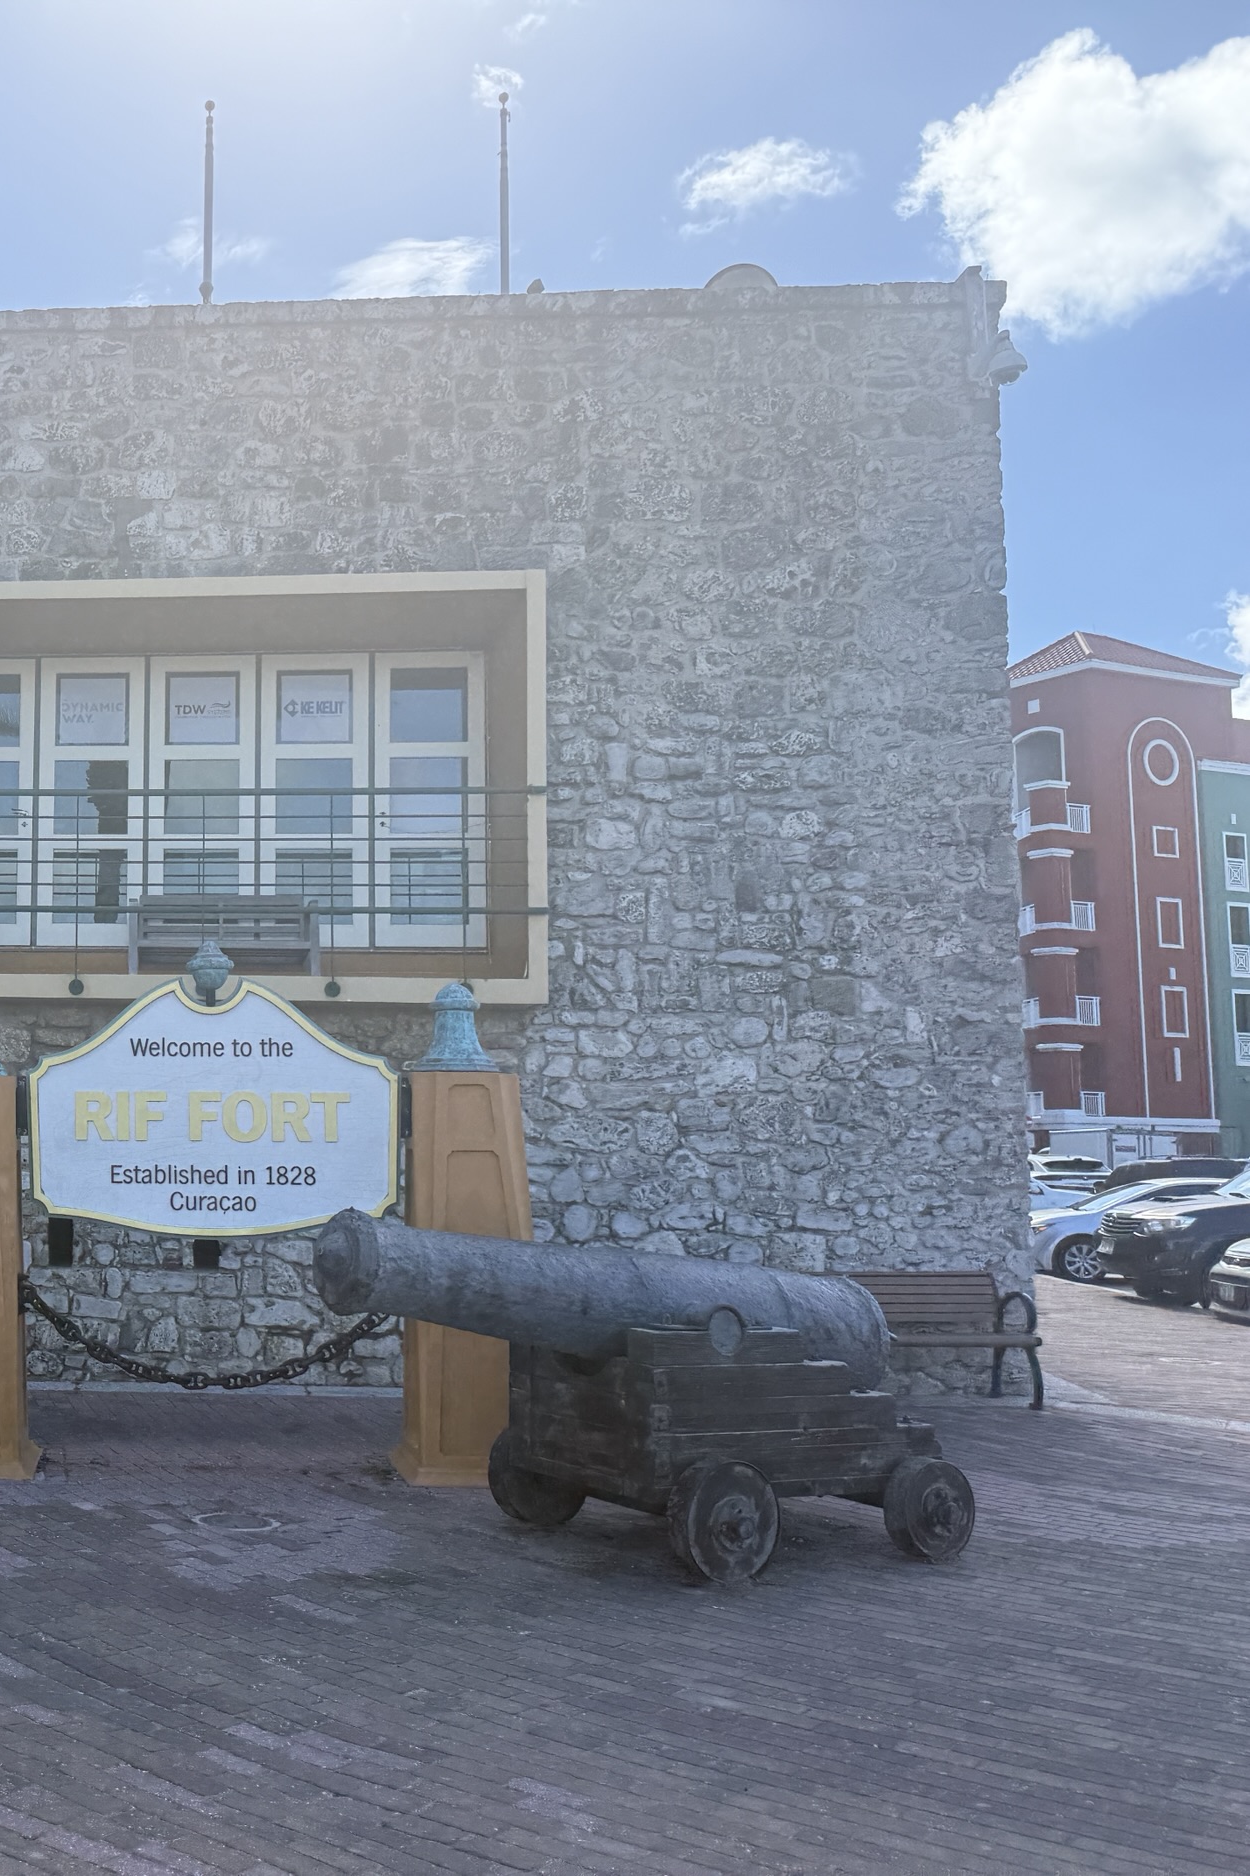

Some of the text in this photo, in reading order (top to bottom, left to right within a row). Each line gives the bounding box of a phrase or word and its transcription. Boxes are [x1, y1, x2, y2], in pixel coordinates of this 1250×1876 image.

[61, 702, 124, 713] DYNAMIC
[174, 704, 207, 715] TDW
[300, 700, 344, 715] KE KELIT
[62, 713, 94, 724] WAY.
[129, 1037, 294, 1058] Welcome to the
[74, 1090, 351, 1143] RIF FORT
[110, 1164, 317, 1186] Established in 1828
[169, 1191, 257, 1214] Curaçao
